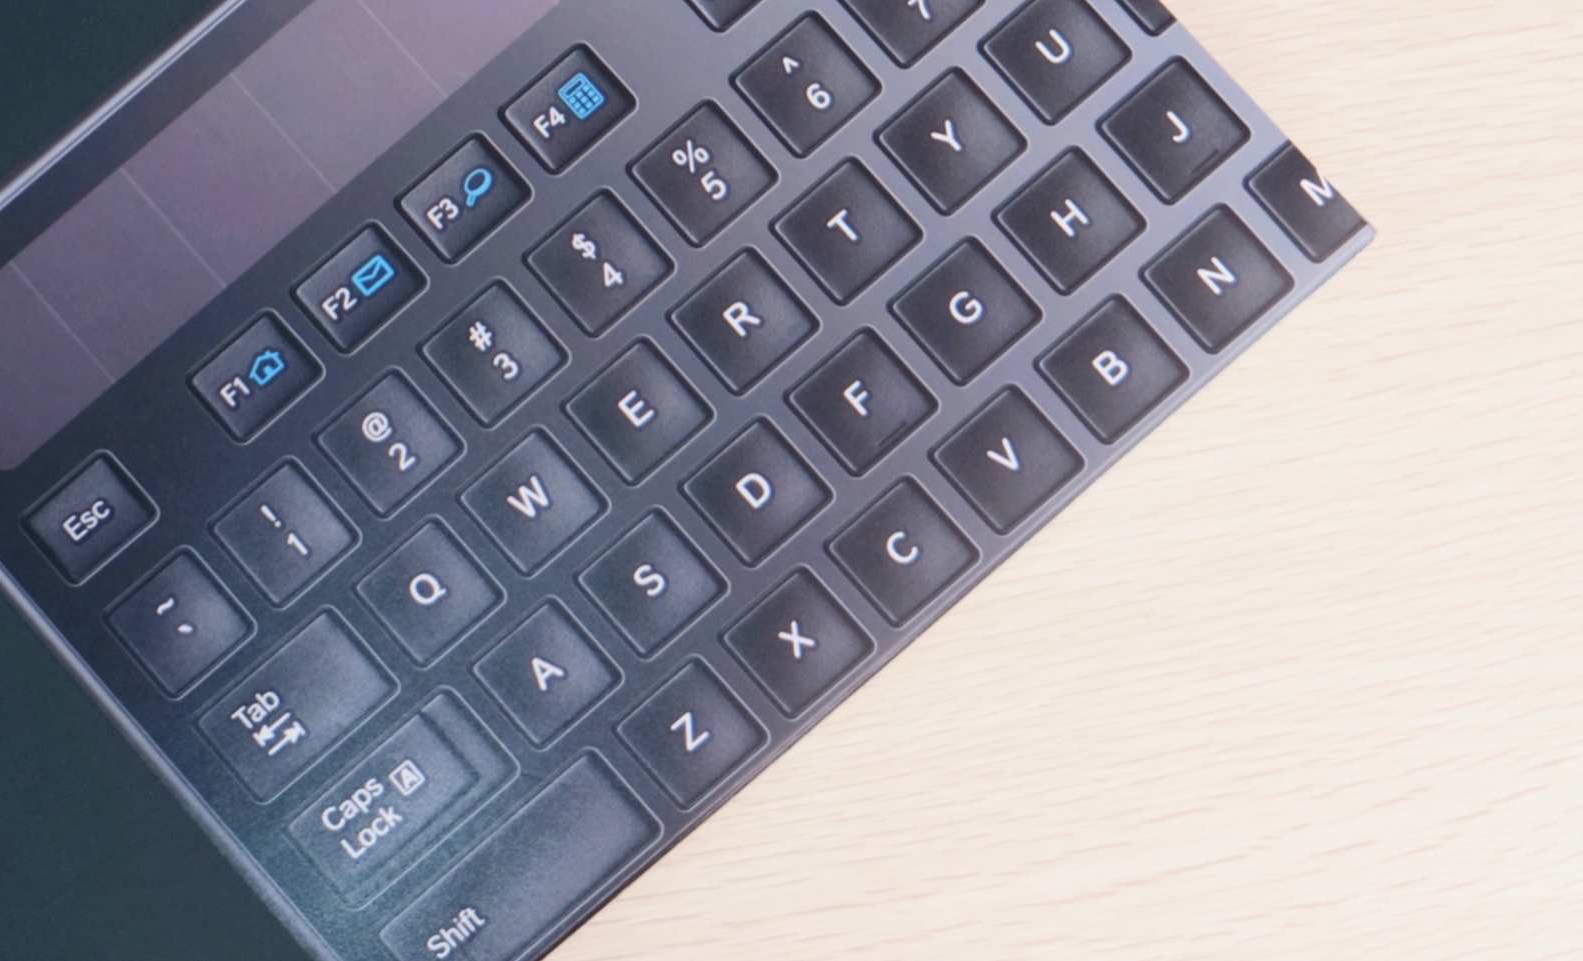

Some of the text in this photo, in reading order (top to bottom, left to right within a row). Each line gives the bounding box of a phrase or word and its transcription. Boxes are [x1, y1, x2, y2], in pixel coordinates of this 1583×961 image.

[1035, 29, 1070, 64] U
[806, 83, 831, 110] 6
[533, 106, 566, 138] F4
[930, 119, 962, 152] Y
[1166, 110, 1189, 143] J
[672, 139, 709, 173] %
[700, 170, 726, 200] 5
[426, 198, 459, 229] F3
[826, 209, 857, 241] T
[1050, 198, 1089, 237] H
[571, 233, 596, 260] $
[603, 262, 623, 287] 4
[1197, 256, 1235, 295] N
[321, 287, 357, 320] F2
[722, 301, 761, 337] R
[949, 291, 982, 324] G
[469, 321, 492, 351] #
[493, 353, 518, 380] 3
[1097, 349, 1130, 387] B
[219, 377, 250, 407] F1
[618, 390, 654, 427] E
[843, 380, 868, 416] F
[361, 411, 392, 443] @
[388, 442, 416, 471] 2
[986, 437, 1019, 471] V
[507, 475, 549, 518] W
[735, 472, 771, 509] D
[62, 500, 110, 541] Esc
[260, 505, 281, 528] !
[287, 533, 308, 555] 1
[886, 531, 918, 564] C
[409, 573, 446, 605] Q
[633, 564, 665, 596] S
[778, 620, 815, 659] X
[531, 657, 564, 691] A
[230, 690, 280, 730] Tab
[670, 712, 709, 752] Z
[320, 776, 384, 832] Caps
[339, 807, 404, 860] Lock
[426, 907, 485, 959] Shift
